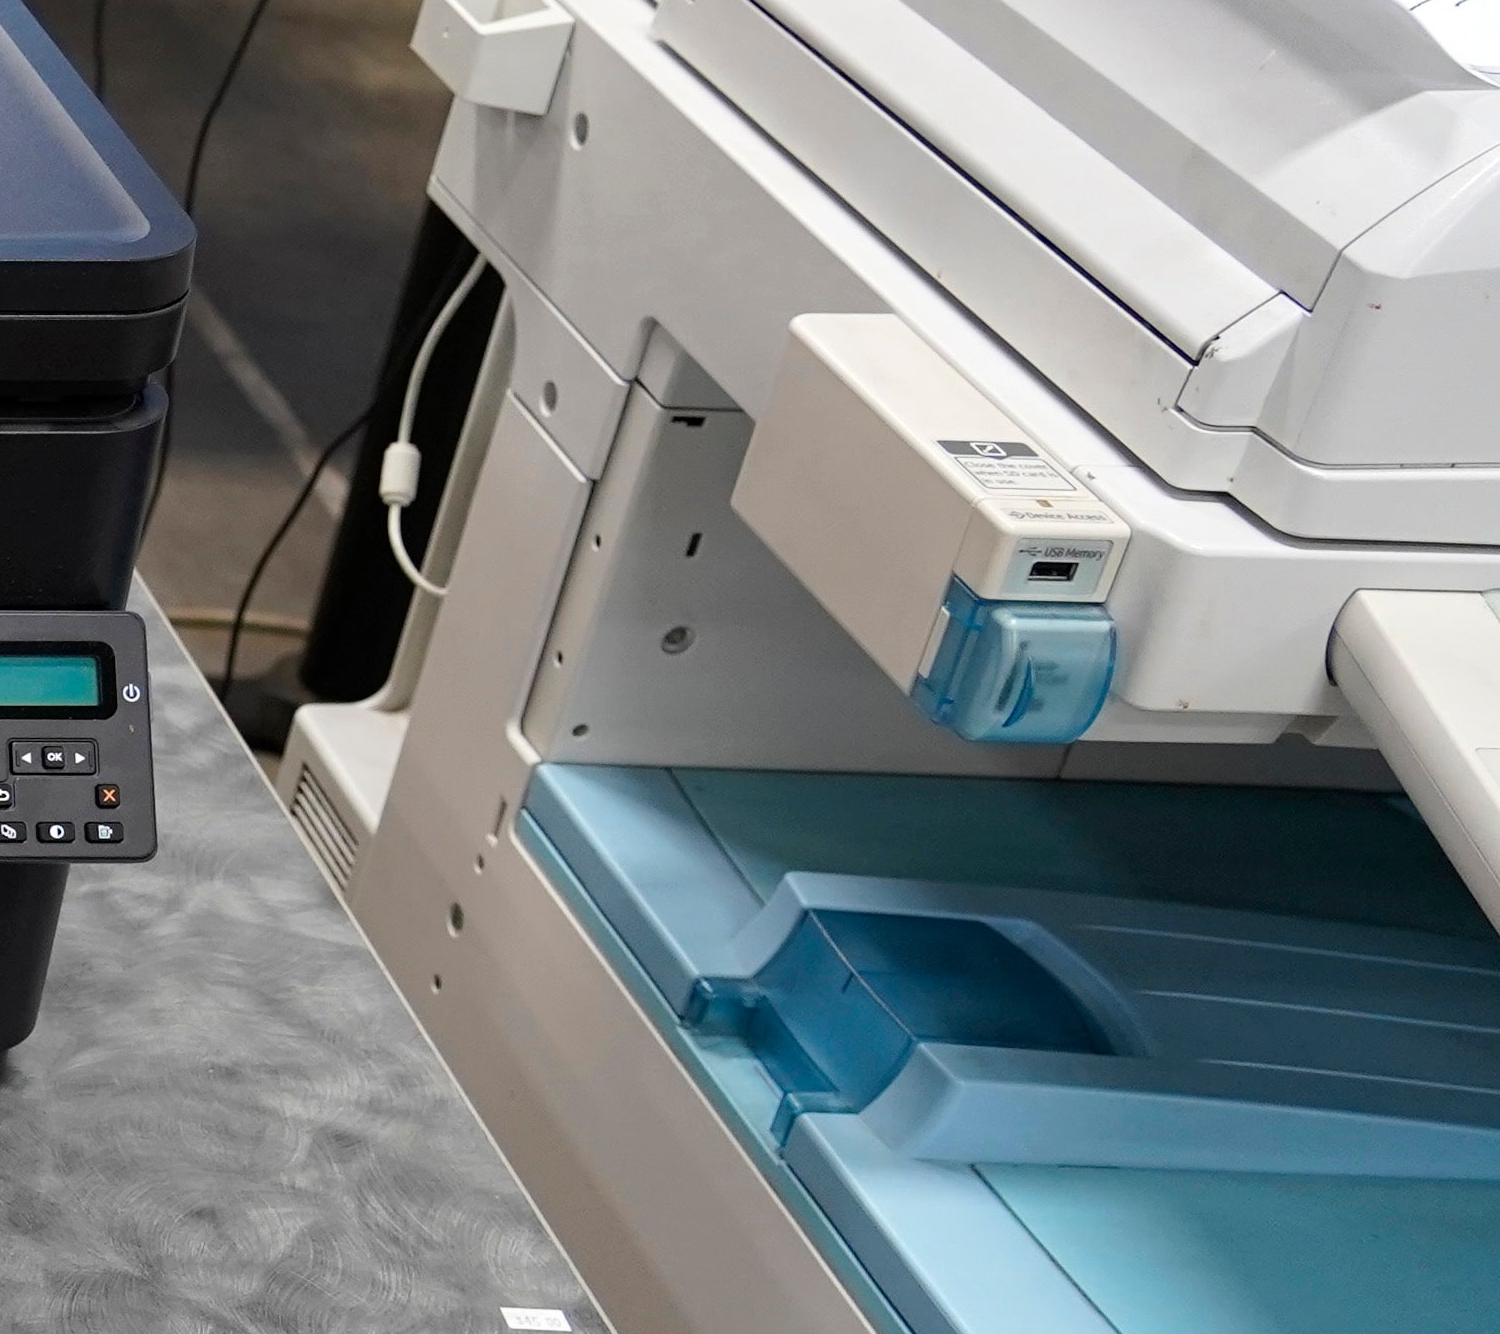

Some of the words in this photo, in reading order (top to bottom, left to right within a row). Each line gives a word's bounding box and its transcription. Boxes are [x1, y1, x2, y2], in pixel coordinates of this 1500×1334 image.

[1044, 547, 1065, 557] USB
[1065, 548, 1105, 561] Memory
[47, 752, 63, 762] OK
